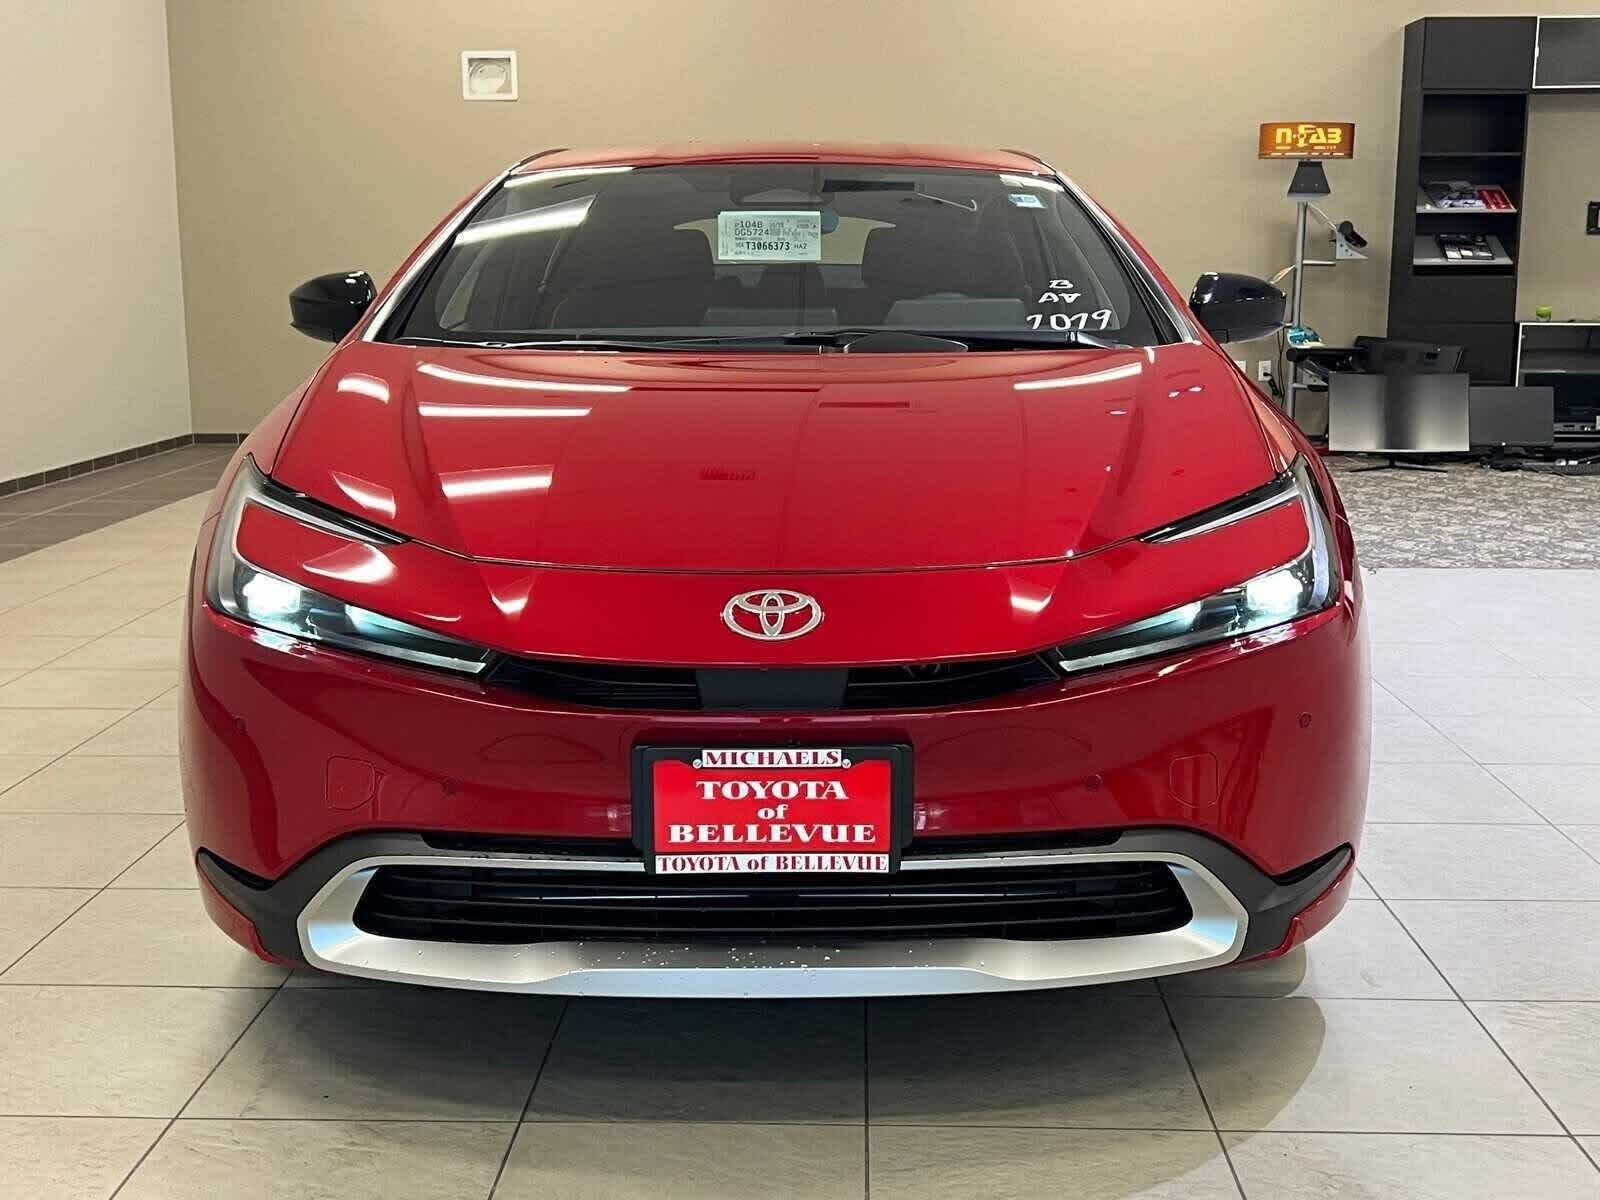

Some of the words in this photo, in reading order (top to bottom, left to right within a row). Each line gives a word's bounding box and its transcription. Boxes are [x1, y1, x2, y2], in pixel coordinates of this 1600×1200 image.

[746, 241, 790, 250] T3066373
[706, 751, 840, 765] MICHAELS
[696, 781, 848, 800] TOYOTA
[757, 804, 789, 820] of
[668, 824, 876, 843] BELLEVUE
[657, 856, 740, 872] TOYOTA
[747, 855, 769, 871] of
[775, 856, 888, 872] BELLEVUE
